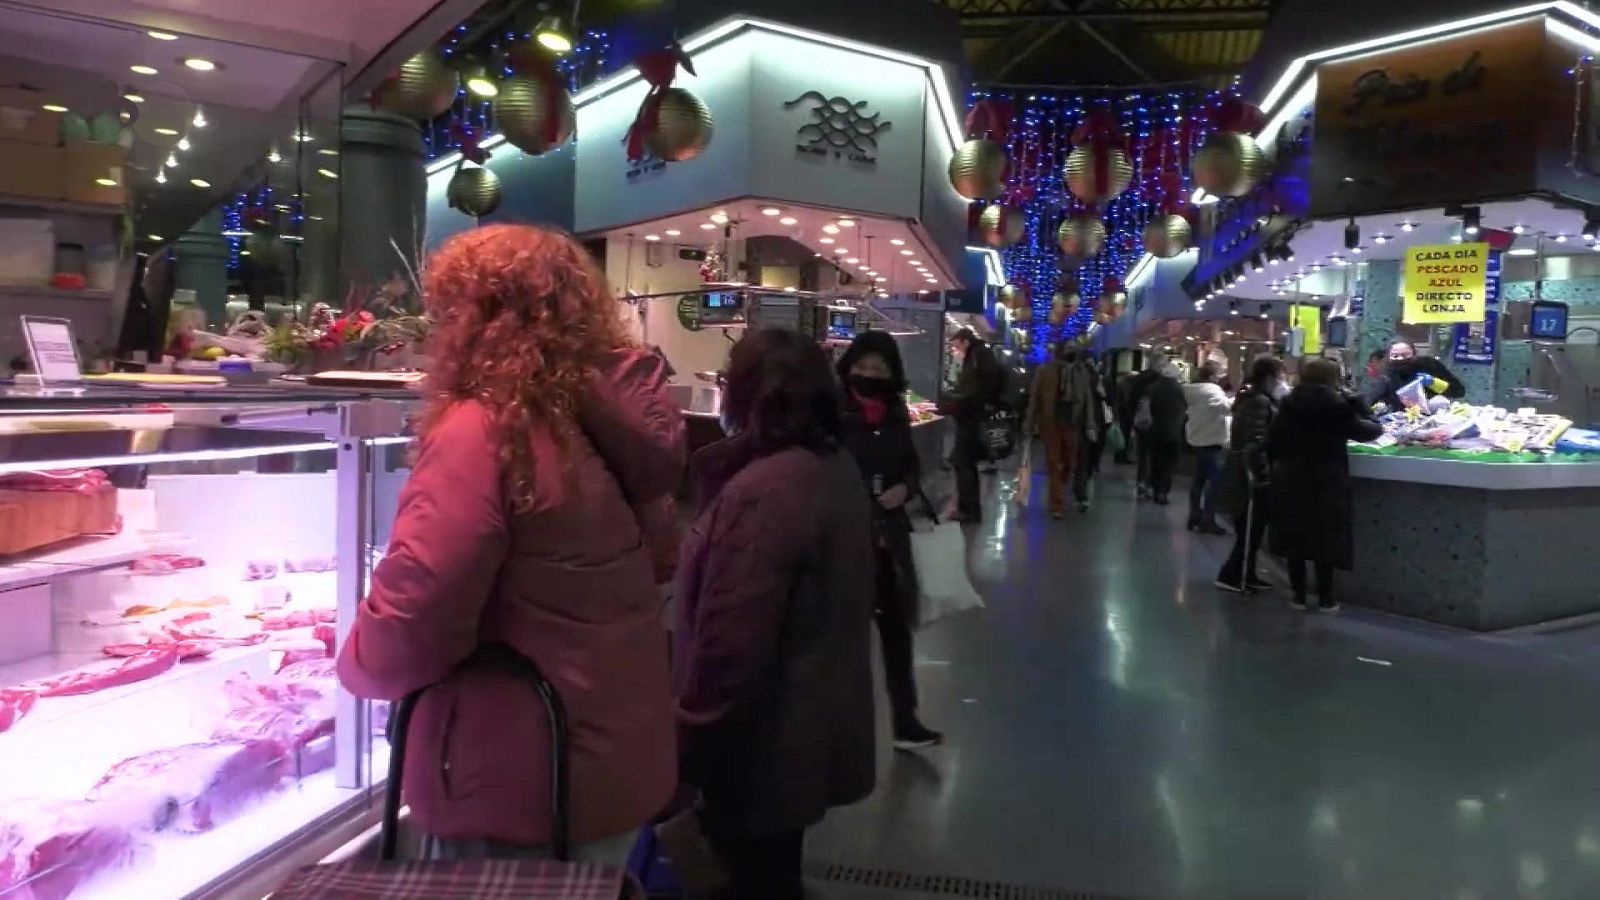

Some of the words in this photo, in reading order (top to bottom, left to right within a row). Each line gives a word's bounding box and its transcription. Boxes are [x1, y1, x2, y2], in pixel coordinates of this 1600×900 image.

[1416, 251, 1451, 262] CADA
[1417, 264, 1479, 274] PESCADO
[1428, 278, 1464, 287] AZUL
[1416, 292, 1473, 301] DIRECTO
[1422, 304, 1466, 313] LONJA
[1541, 319, 1557, 332] 17
